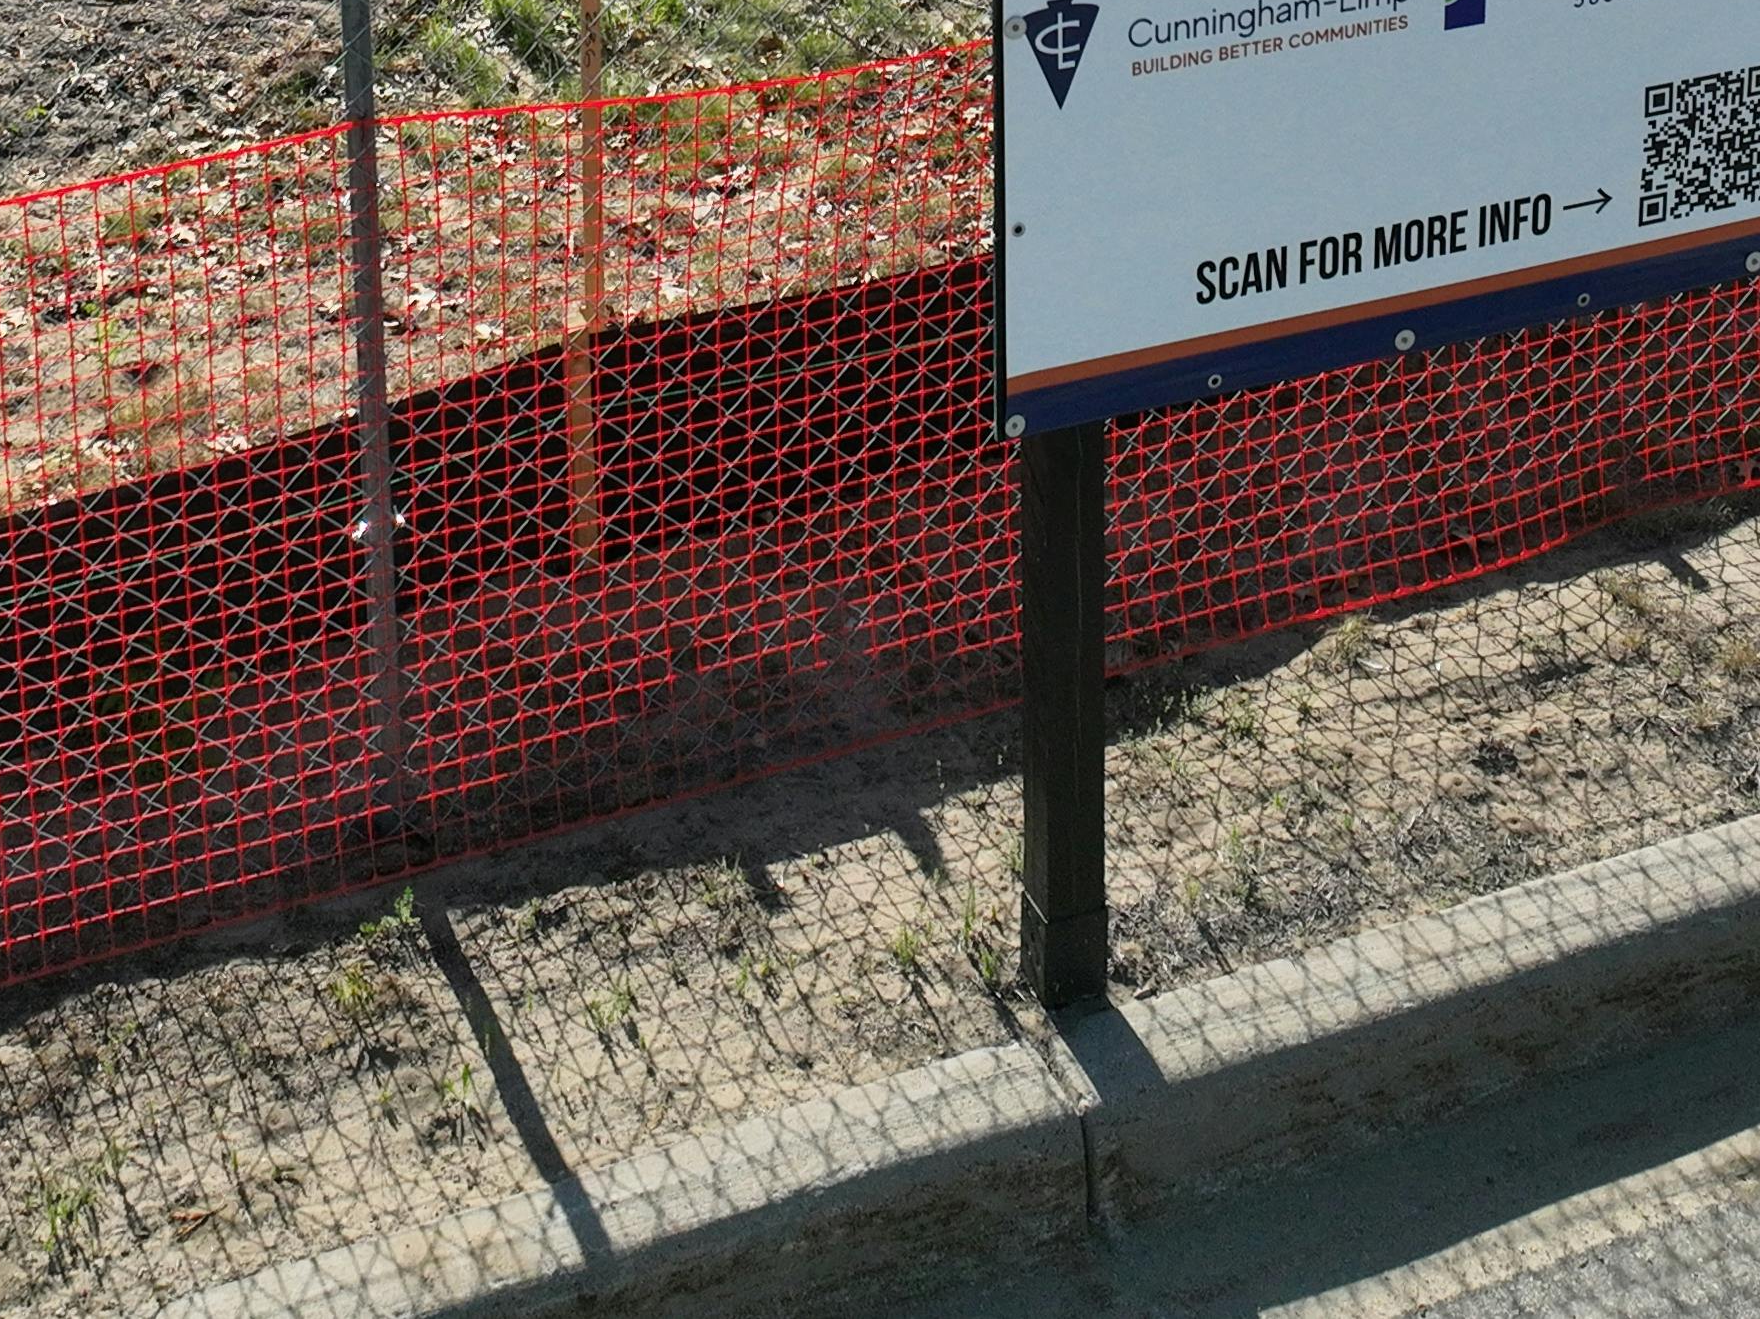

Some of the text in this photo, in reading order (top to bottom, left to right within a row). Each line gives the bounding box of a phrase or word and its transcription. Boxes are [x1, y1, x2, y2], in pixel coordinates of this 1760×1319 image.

[1132, 14, 1409, 77] BUILDING BETTER COMMUNITIES
[1196, 193, 1553, 305] SCAN FOR MORE INFO
